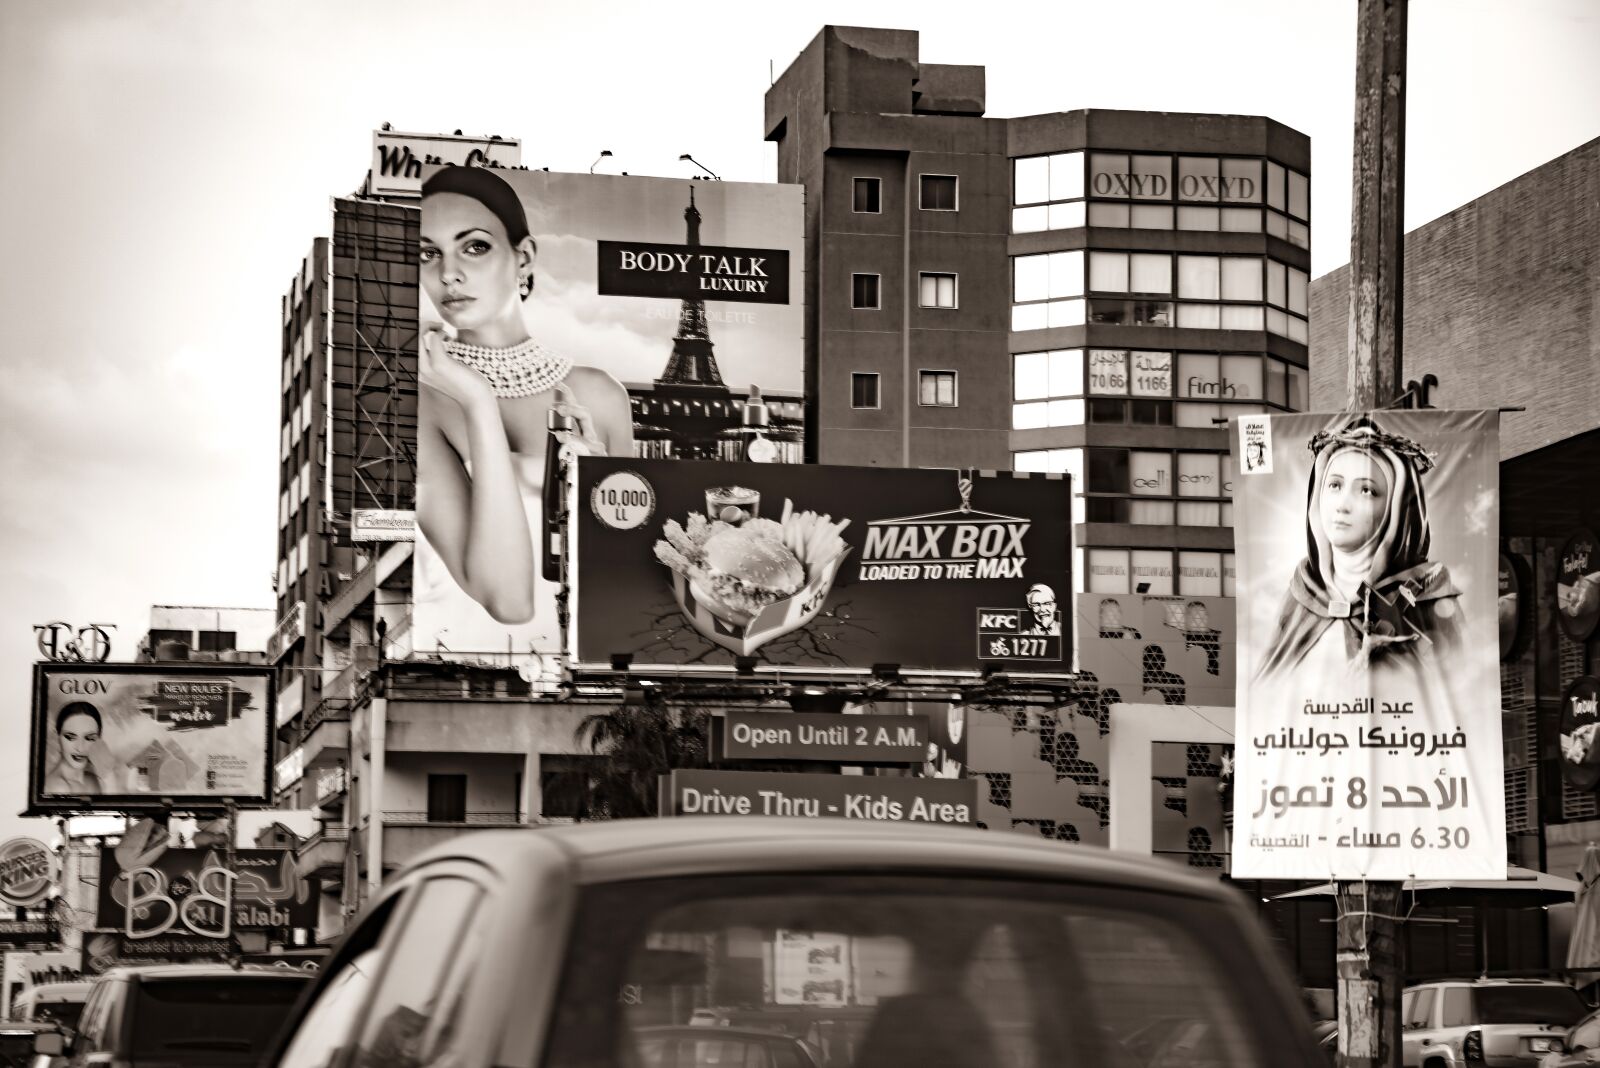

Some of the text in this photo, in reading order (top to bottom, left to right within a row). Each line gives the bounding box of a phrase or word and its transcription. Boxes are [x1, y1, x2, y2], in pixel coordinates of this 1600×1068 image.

[1094, 171, 1167, 197] OXYD
[1180, 174, 1255, 200] OXYD
[619, 250, 769, 277] BODY TALK
[699, 277, 769, 293] LUXURY
[680, 309, 694, 321] DE
[699, 310, 758, 324] TOILETTE
[1137, 376, 1168, 391] 1166
[600, 488, 648, 508] 10,000
[615, 508, 628, 521] LL
[861, 523, 1030, 559] MAX BOX
[859, 556, 1027, 582] LOADED TO THE MAX
[980, 613, 1018, 629] KFC
[1012, 638, 1048, 657] 1277
[59, 679, 112, 695] GLOV
[164, 685, 223, 694] NEW RULES
[1303, 698, 1413, 720] عيد القديسة
[732, 723, 922, 748] Open Until 2 A.M.
[1253, 726, 1467, 757] فيرونيكا جولياني
[1252, 767, 1469, 820] الأحد 8 تموز
[682, 788, 751, 816] Drive
[758, 789, 819, 818] Thru
[844, 793, 903, 821] Kids
[909, 797, 970, 823] Area
[1410, 826, 1470, 849] 6.30
[235, 900, 291, 924] alabi
